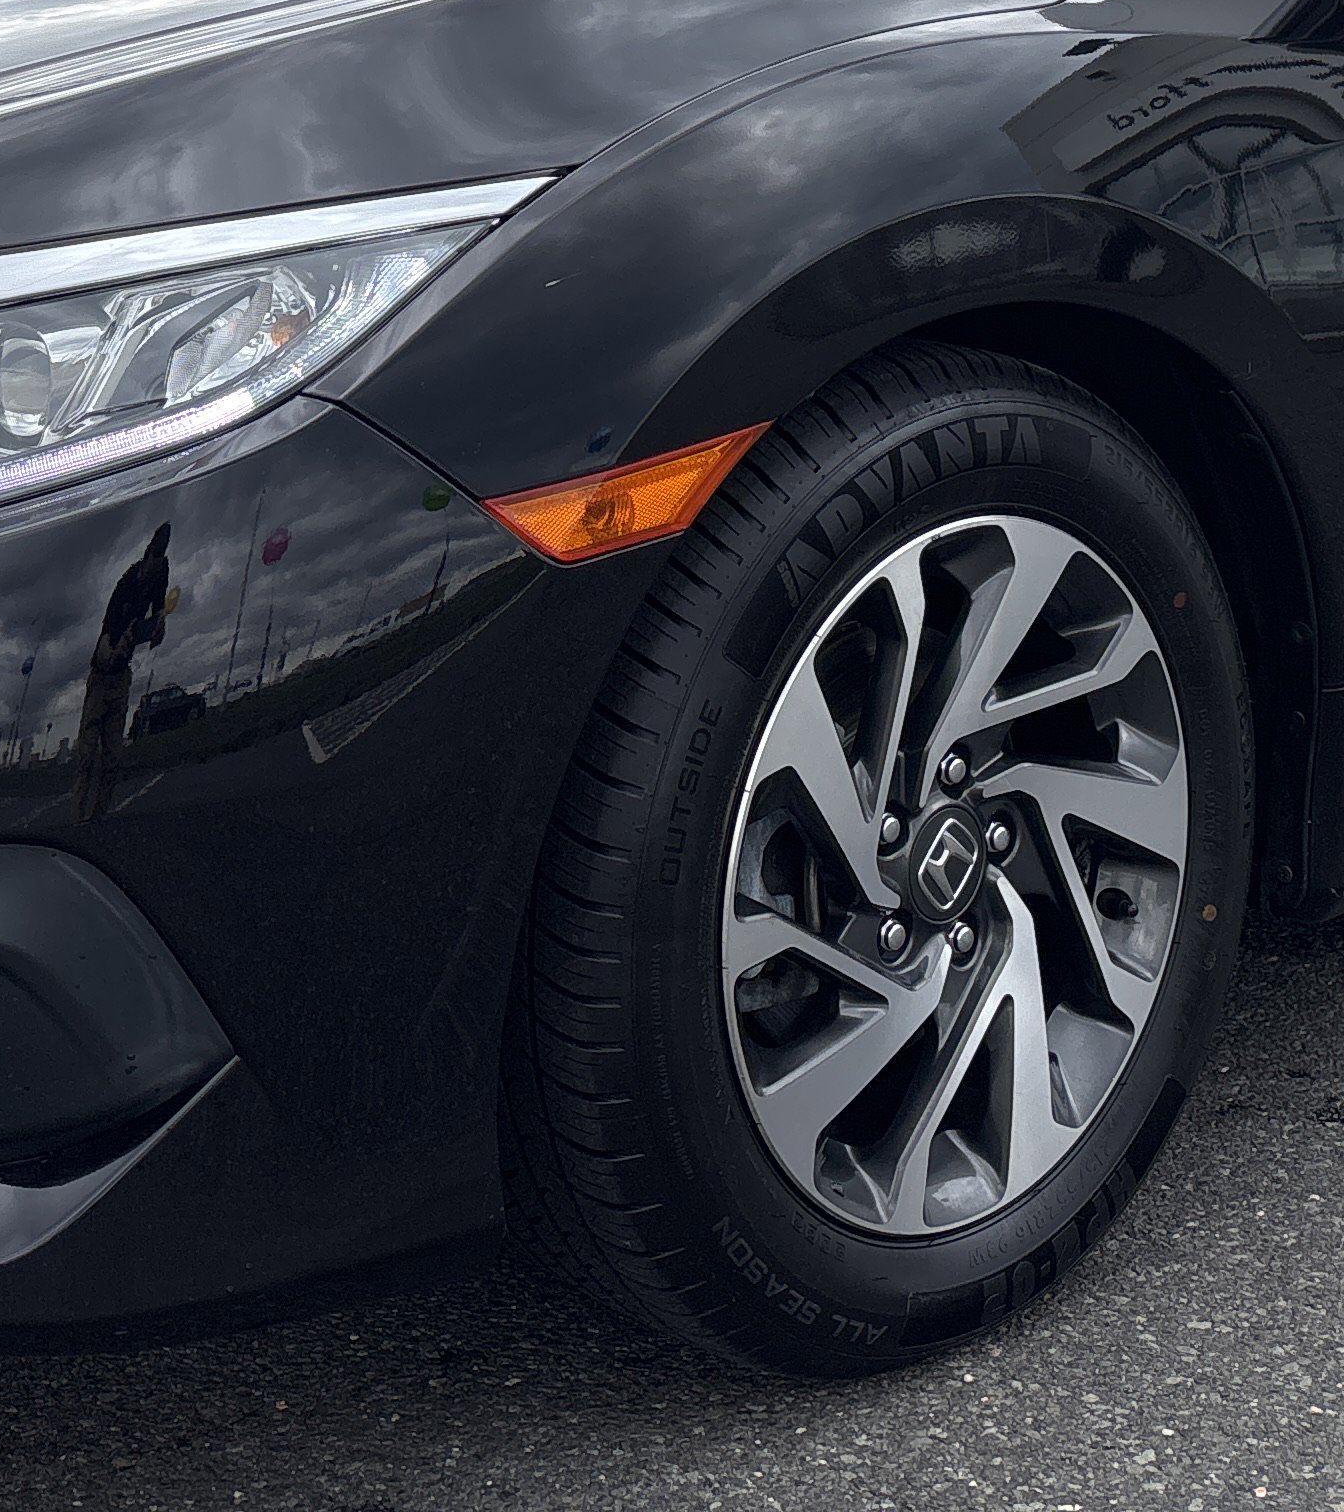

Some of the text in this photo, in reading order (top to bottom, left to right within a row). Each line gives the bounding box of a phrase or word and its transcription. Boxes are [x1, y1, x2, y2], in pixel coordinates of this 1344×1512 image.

[784, 415, 1043, 604] ADVANTA
[659, 700, 722, 889] OUTSIDE
[710, 1215, 821, 1326] SEASON
[830, 1315, 889, 1348] ALL
